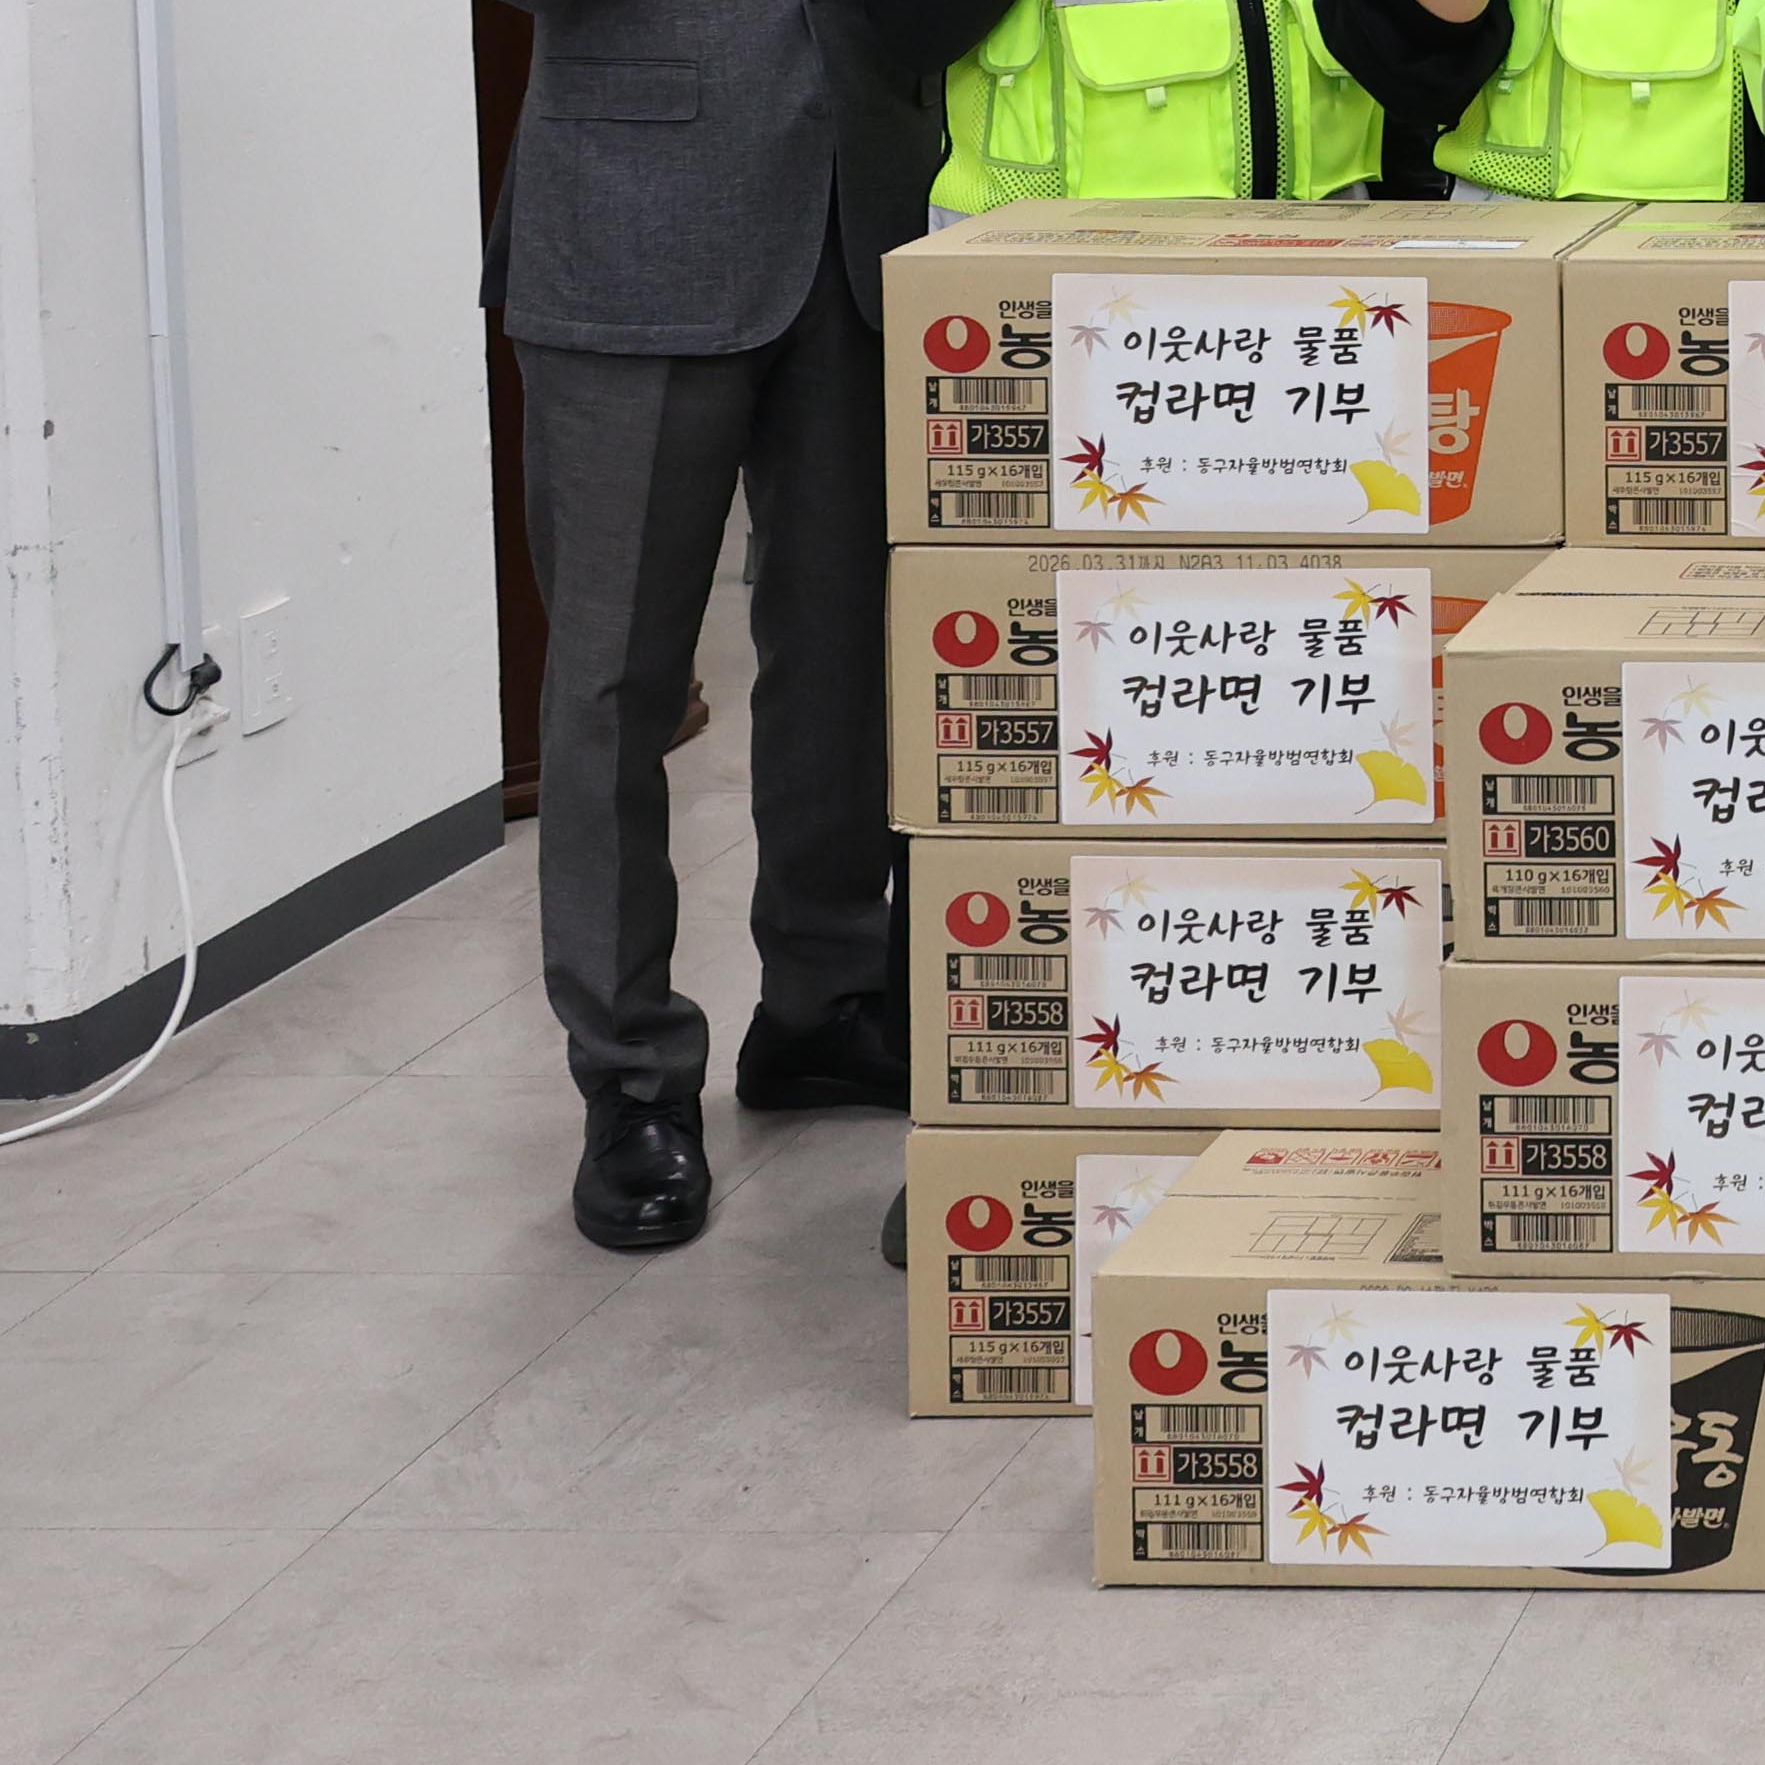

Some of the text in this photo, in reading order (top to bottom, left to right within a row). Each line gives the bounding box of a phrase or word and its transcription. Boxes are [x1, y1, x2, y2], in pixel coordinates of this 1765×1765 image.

[1124, 325, 1363, 367] 이웃사랑 물품
[1116, 380, 1371, 425] 컵라면 기부
[971, 424, 1044, 449] 가3557
[1140, 456, 1348, 476] 후원 동구자율방범연합회
[1129, 618, 1367, 659] 이웃사랑 물품
[1122, 673, 1376, 719] 컵라면 기부
[981, 720, 1053, 745] 가3557
[1530, 825, 1610, 853] 가3560
[1719, 858, 1754, 877] 후원
[1137, 905, 1375, 948] 이웃사랑 물품
[1130, 961, 1383, 1005] 컵라면 기부
[992, 1000, 1063, 1026] 가3558
[1527, 1143, 1607, 1170] 가3558
[1344, 1345, 1600, 1389] 이웃사랑 물품
[1336, 1403, 1609, 1451] 컵라면 기부
[1178, 1452, 1258, 1479] 가3558
[1362, 1484, 1584, 1505] 후원 동구자율방범연합회
